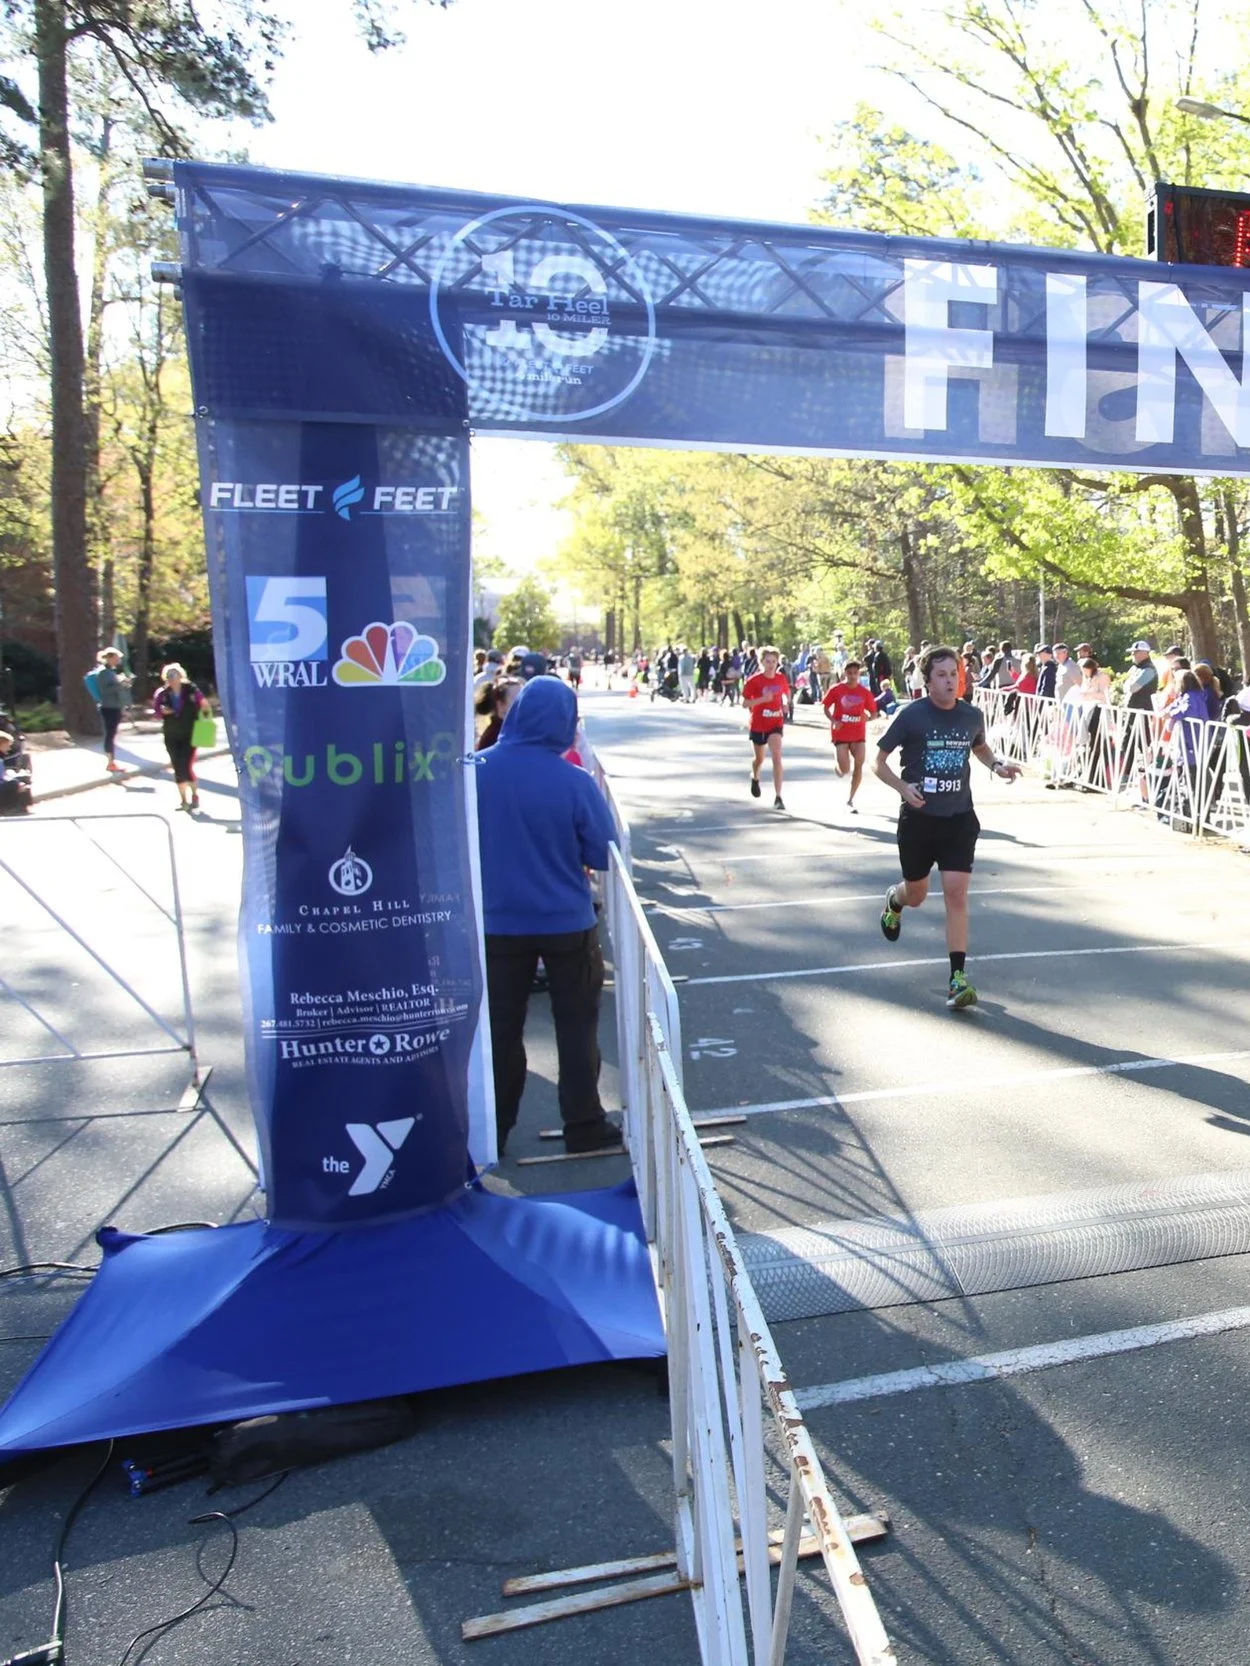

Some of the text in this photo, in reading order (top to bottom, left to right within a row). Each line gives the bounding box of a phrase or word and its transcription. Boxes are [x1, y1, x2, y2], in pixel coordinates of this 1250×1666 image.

[484, 288, 610, 315] Tar Heel
[209, 481, 458, 511] FLEET FEET
[248, 575, 328, 662] 5
[250, 661, 328, 689] WRAL
[244, 740, 436, 789] Publix
[937, 779, 961, 792] 3913
[299, 899, 410, 917] CHAPEL HILL
[256, 909, 452, 935] FAMILY & COSMETIC DENTISTRY
[290, 983, 439, 1005] Rebecca Meschio, Esq.
[296, 1007, 328, 1017] Broker
[336, 1005, 374, 1015] Advisor
[381, 998, 431, 1012] REALTOR
[280, 1028, 451, 1059] Hunter Rowe
[291, 1059, 315, 1068] REAL
[317, 1056, 349, 1065] ESTATE
[351, 1055, 380, 1065] AGENTS
[383, 1055, 403, 1065] AND
[322, 1155, 350, 1174] the
[379, 1169, 397, 1190] YMCA
